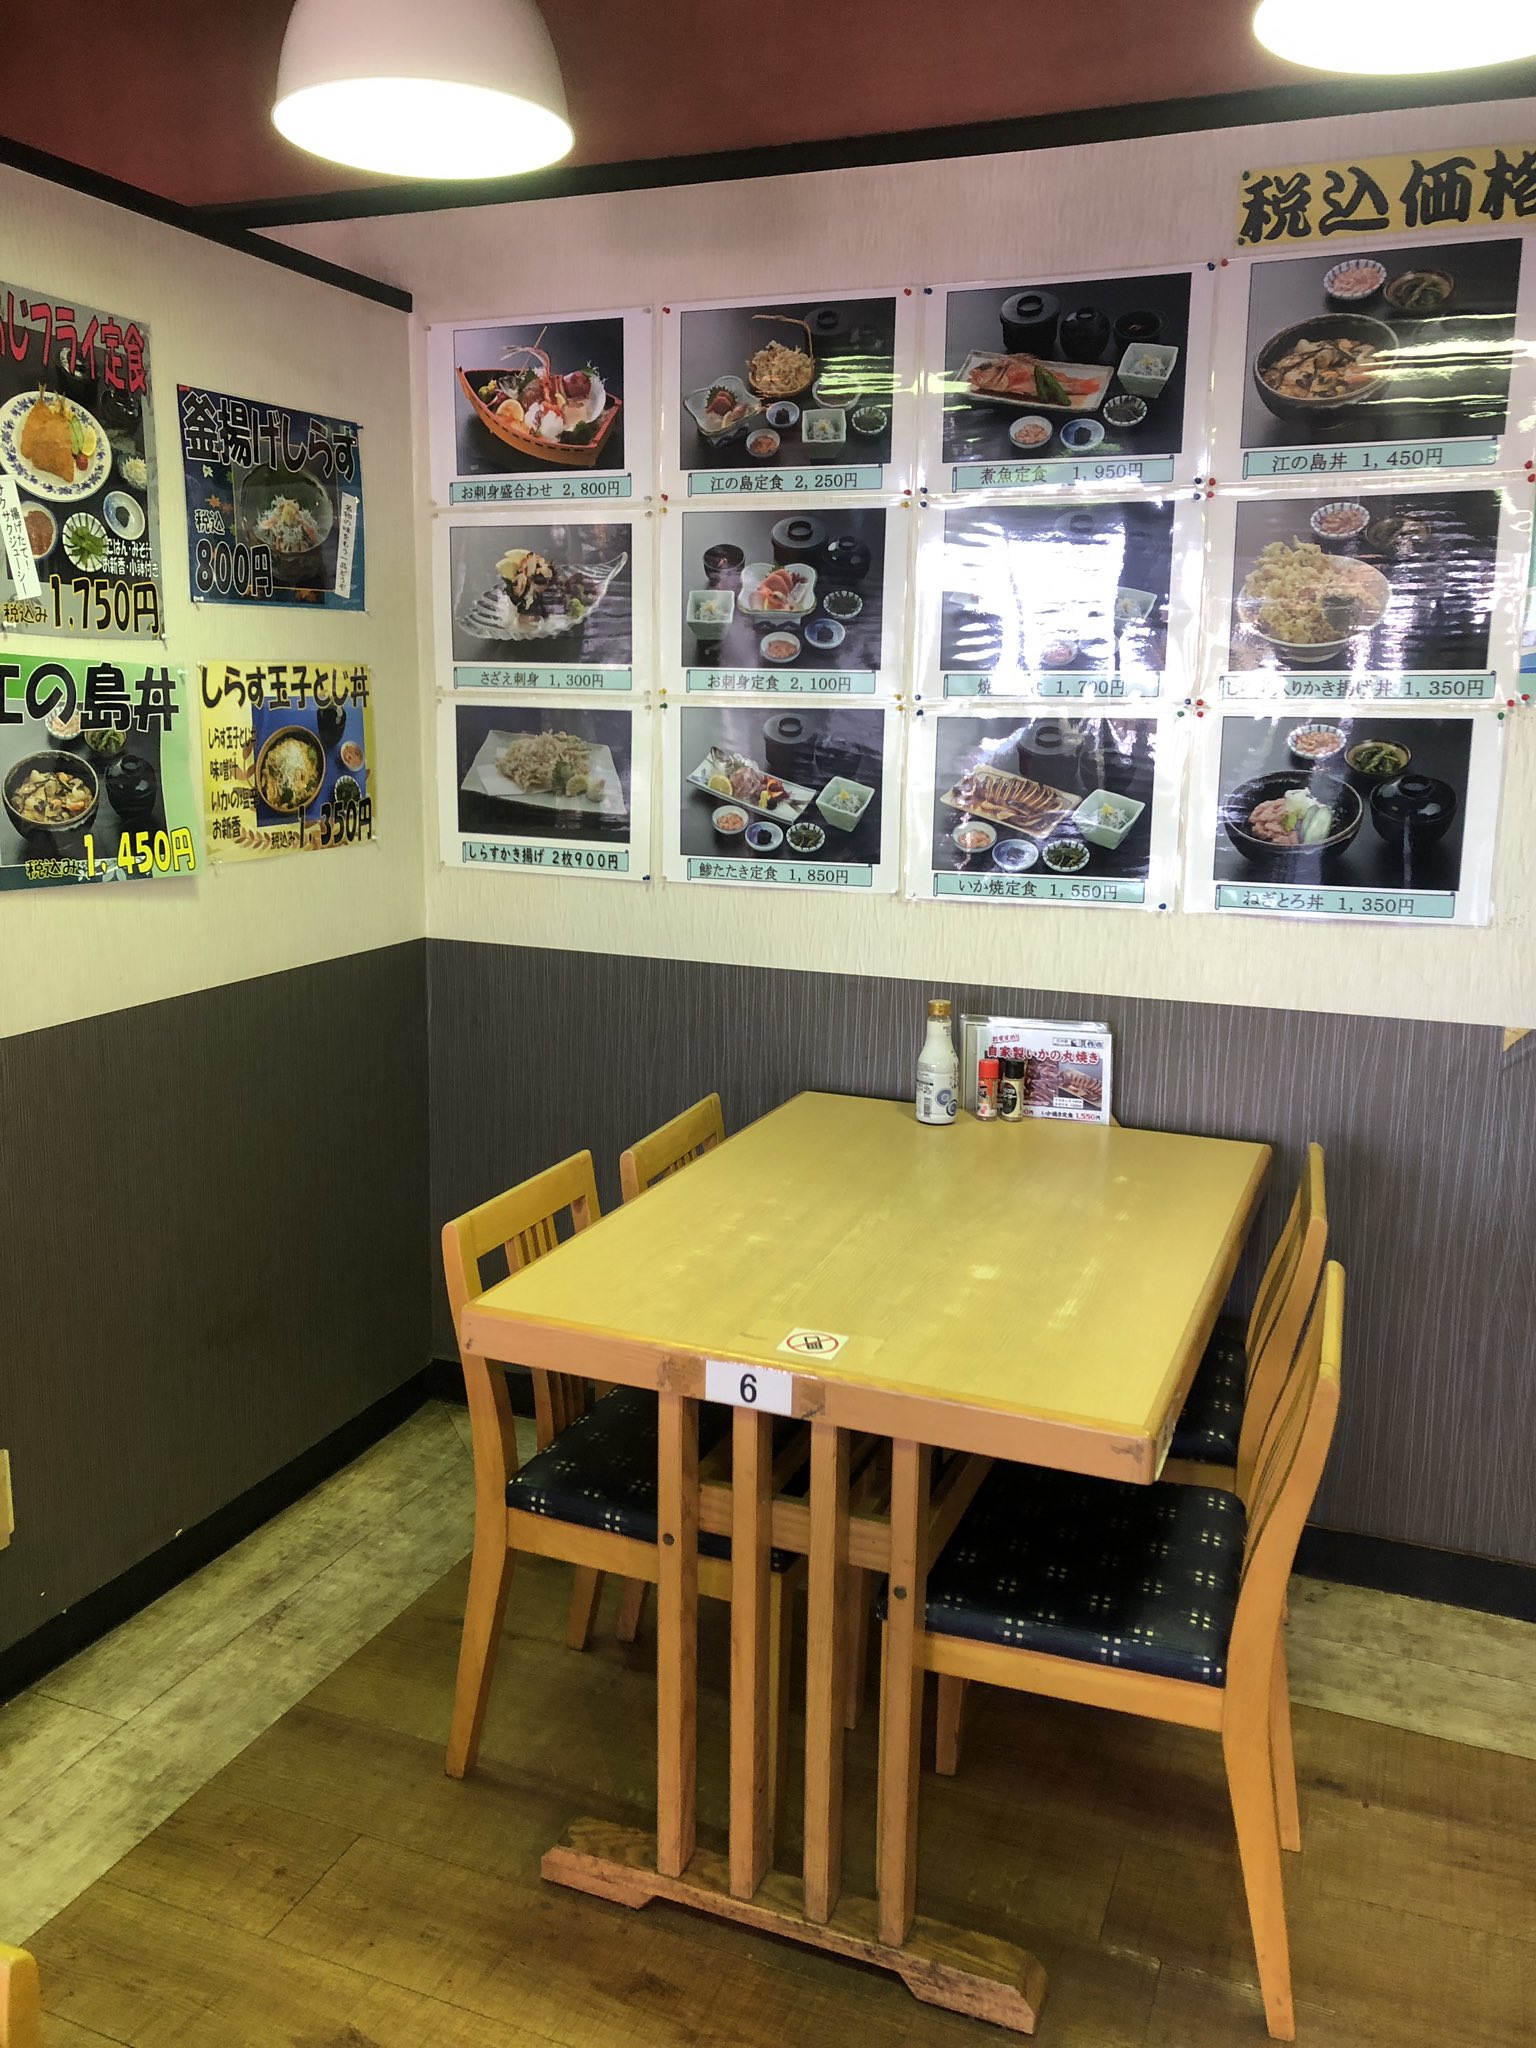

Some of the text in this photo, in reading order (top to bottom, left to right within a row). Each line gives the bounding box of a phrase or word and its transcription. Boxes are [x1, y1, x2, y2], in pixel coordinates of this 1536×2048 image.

[1240, 149, 1536, 243] 税込価格
[181, 390, 358, 484] 釜揚げしらす
[1272, 452, 1348, 473] 江の島丼
[710, 474, 784, 492] 江の島定食
[980, 465, 1048, 484] 煮魚定食
[461, 482, 553, 500] お刺身盛合わせ
[194, 508, 225, 535] 税込
[195, 538, 274, 597] 800円
[4, 603, 48, 624] 税込み
[201, 665, 370, 710] しらす玉子とじ丼
[480, 671, 540, 686] さざえ刺身
[707, 674, 779, 691] お刺身定食
[469, 844, 619, 870] しらすかき揚げ 2枚900円
[958, 879, 1038, 897] いか焼定食
[1242, 890, 1324, 911] ねぎとろ丼
[988, 1045, 1099, 1065] 自家製いかの丸焼き
[740, 1373, 758, 1403] 6
